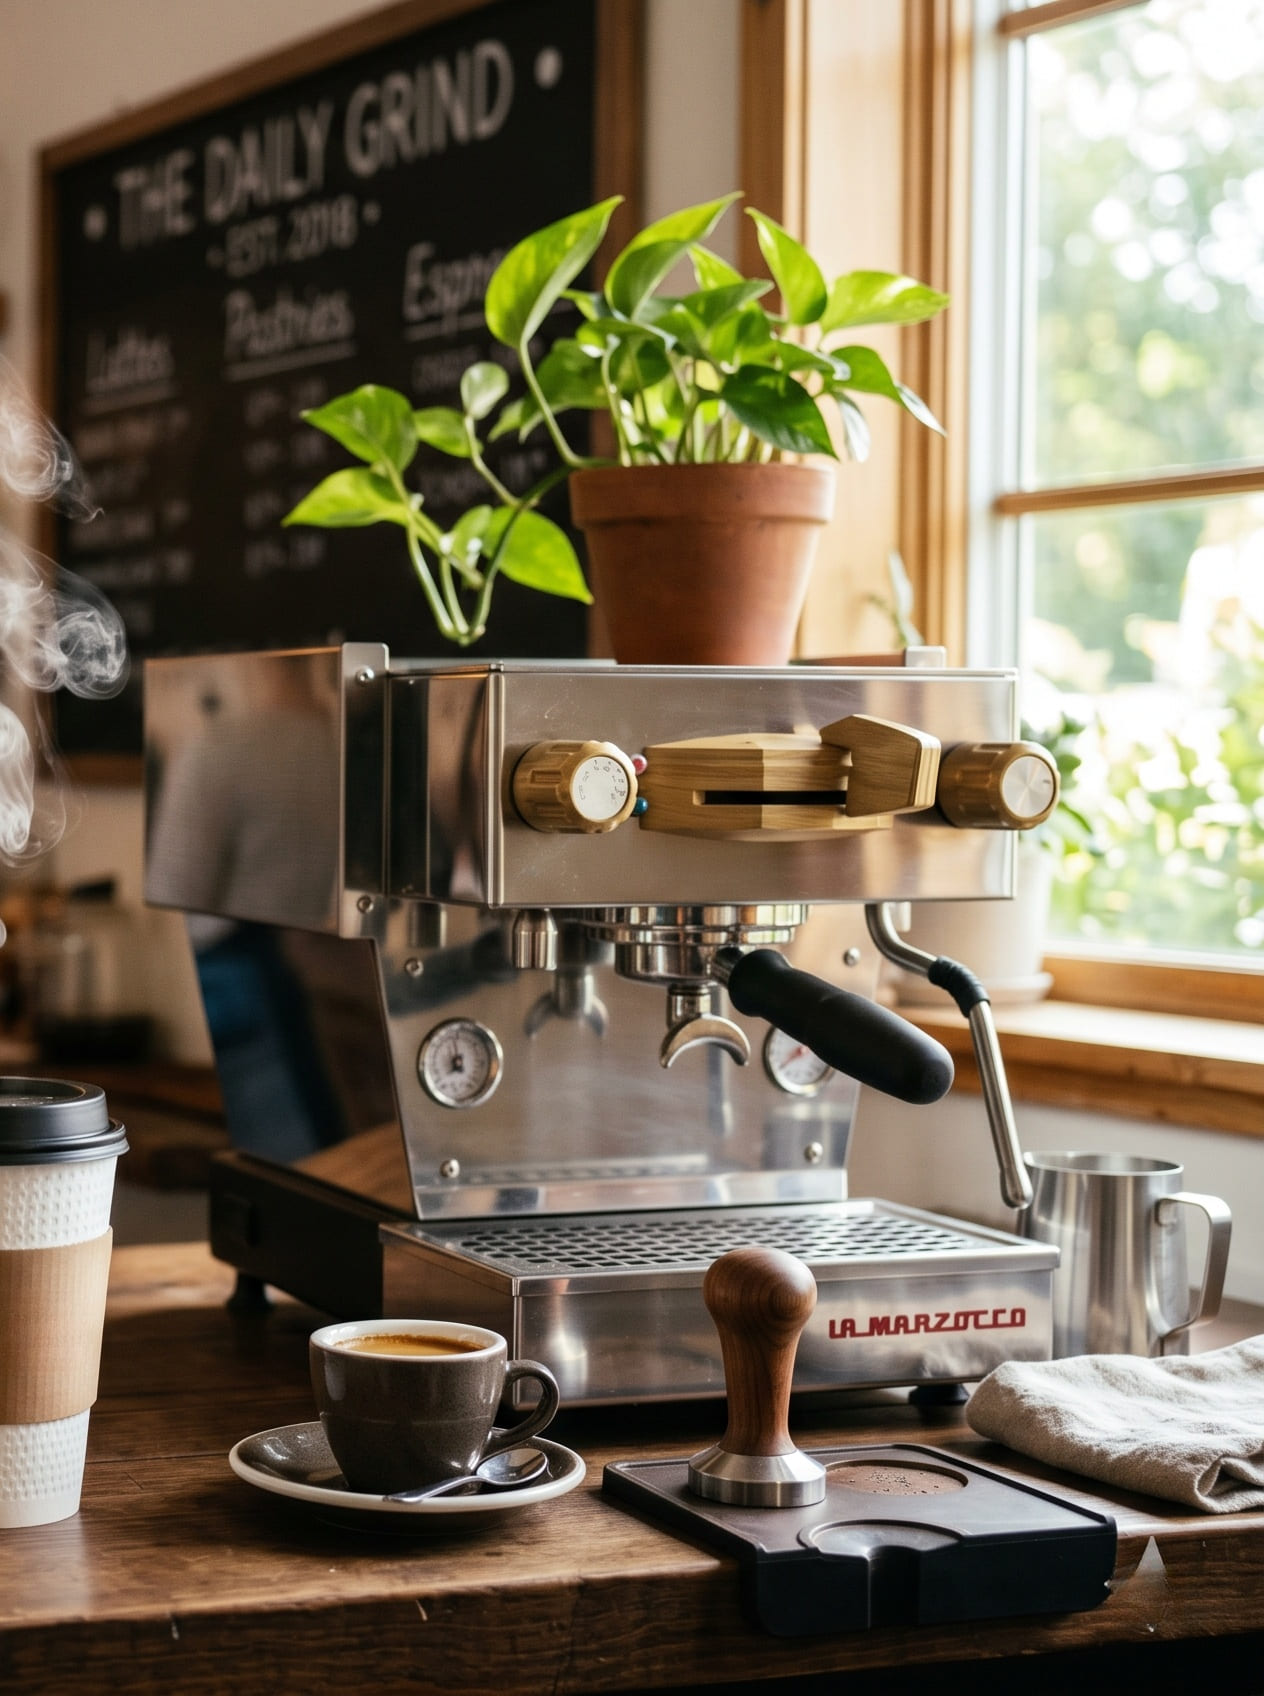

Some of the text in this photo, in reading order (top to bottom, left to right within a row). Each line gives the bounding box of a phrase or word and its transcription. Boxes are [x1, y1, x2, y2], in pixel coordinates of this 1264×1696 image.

[115, 41, 515, 250] THE DAILY GRIND
[224, 288, 355, 360] Pastries
[829, 1319, 857, 1339] LA
